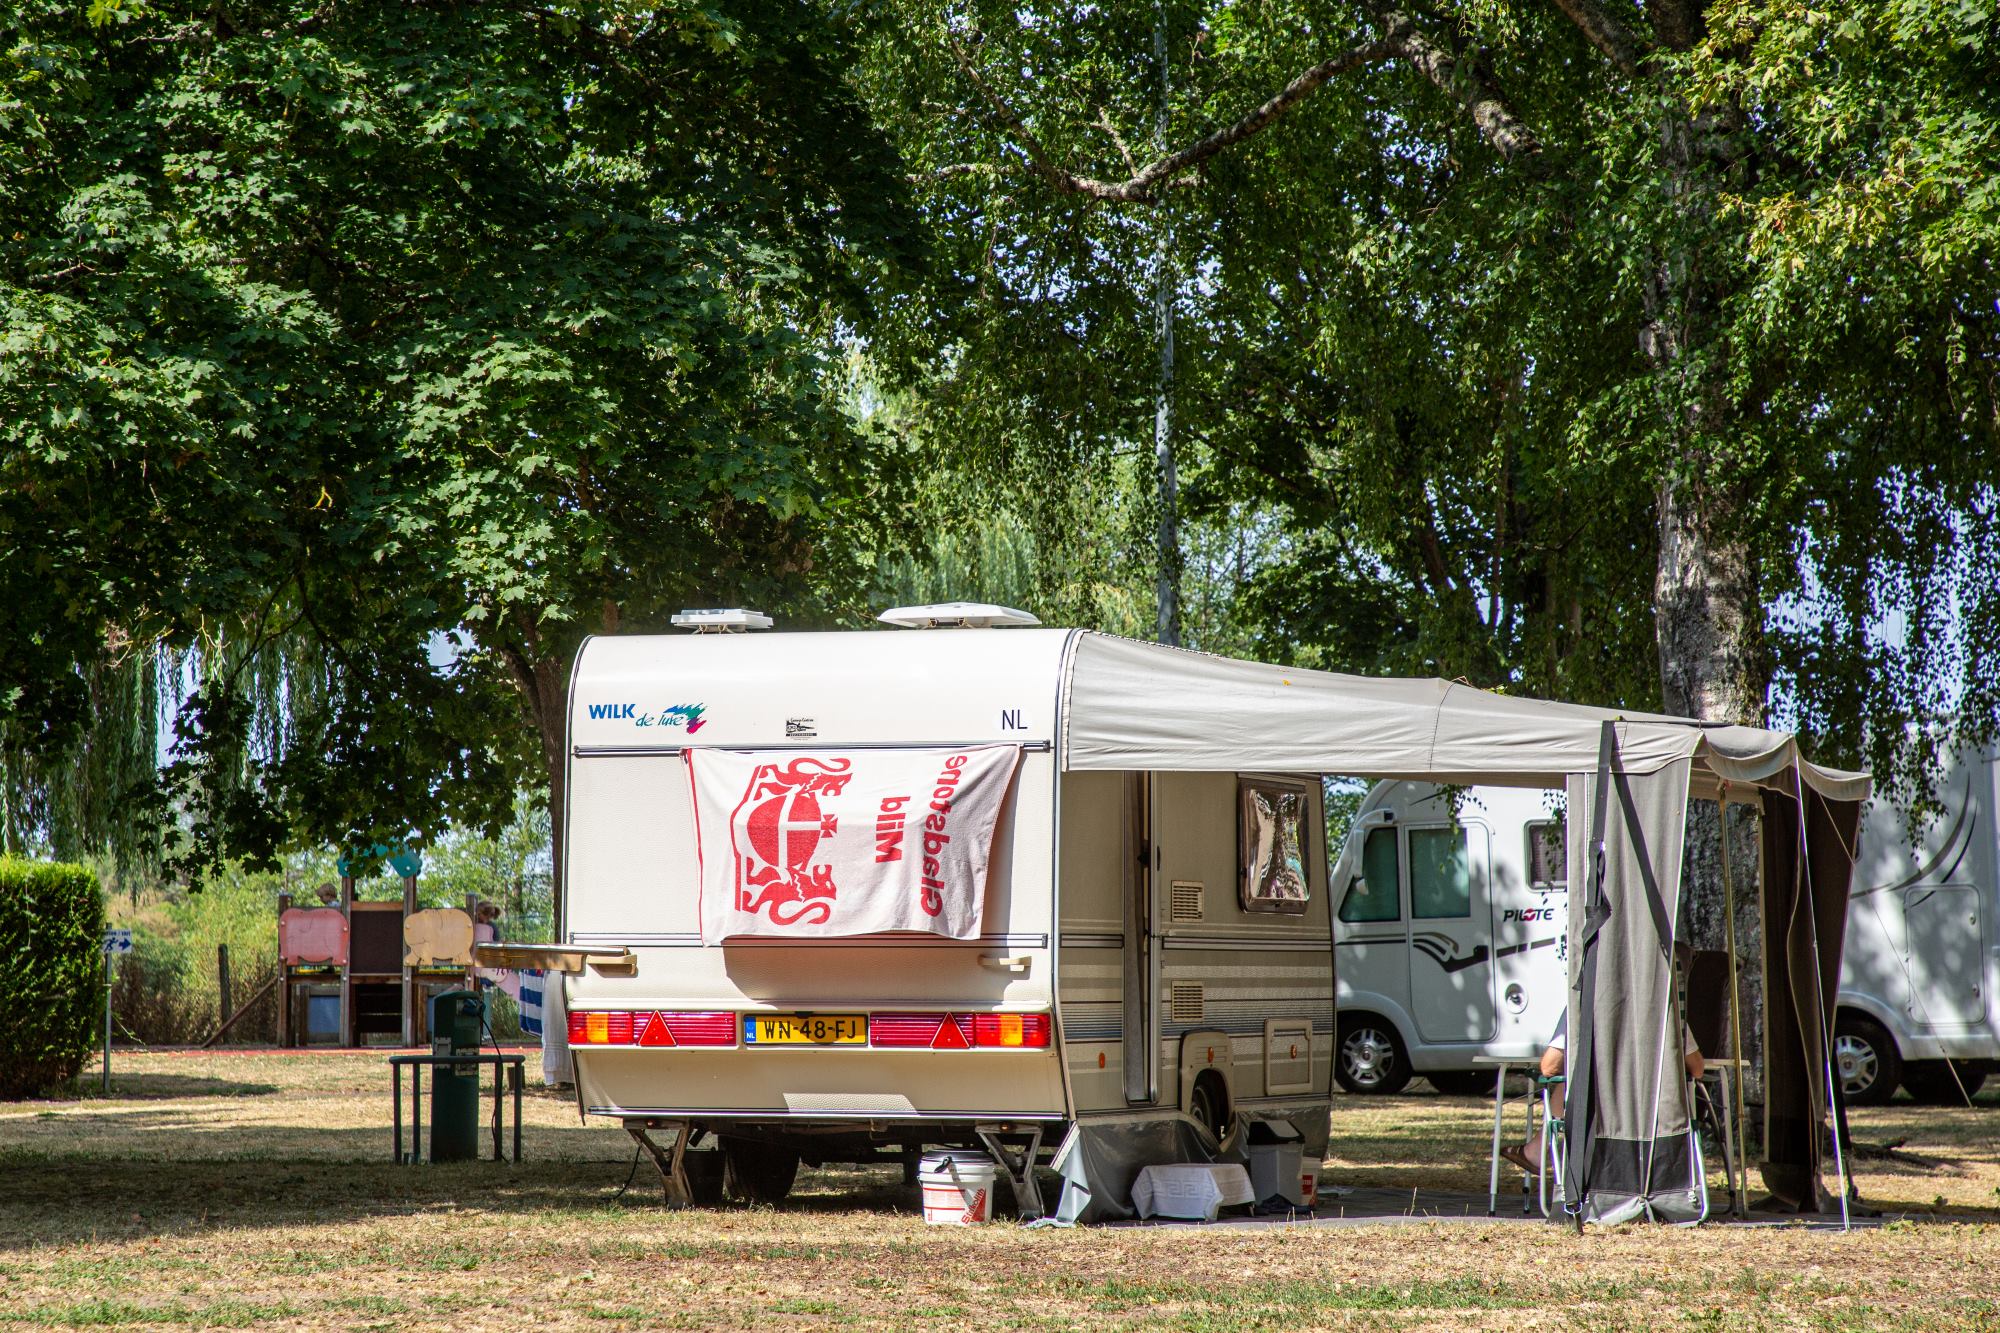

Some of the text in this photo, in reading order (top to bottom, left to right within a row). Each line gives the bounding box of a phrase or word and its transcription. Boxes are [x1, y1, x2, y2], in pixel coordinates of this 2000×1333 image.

[588, 704, 636, 719] WILK
[635, 713, 655, 727] de
[1002, 709, 1028, 730] NL
[764, 1020, 856, 1039] WN-48-FJ
